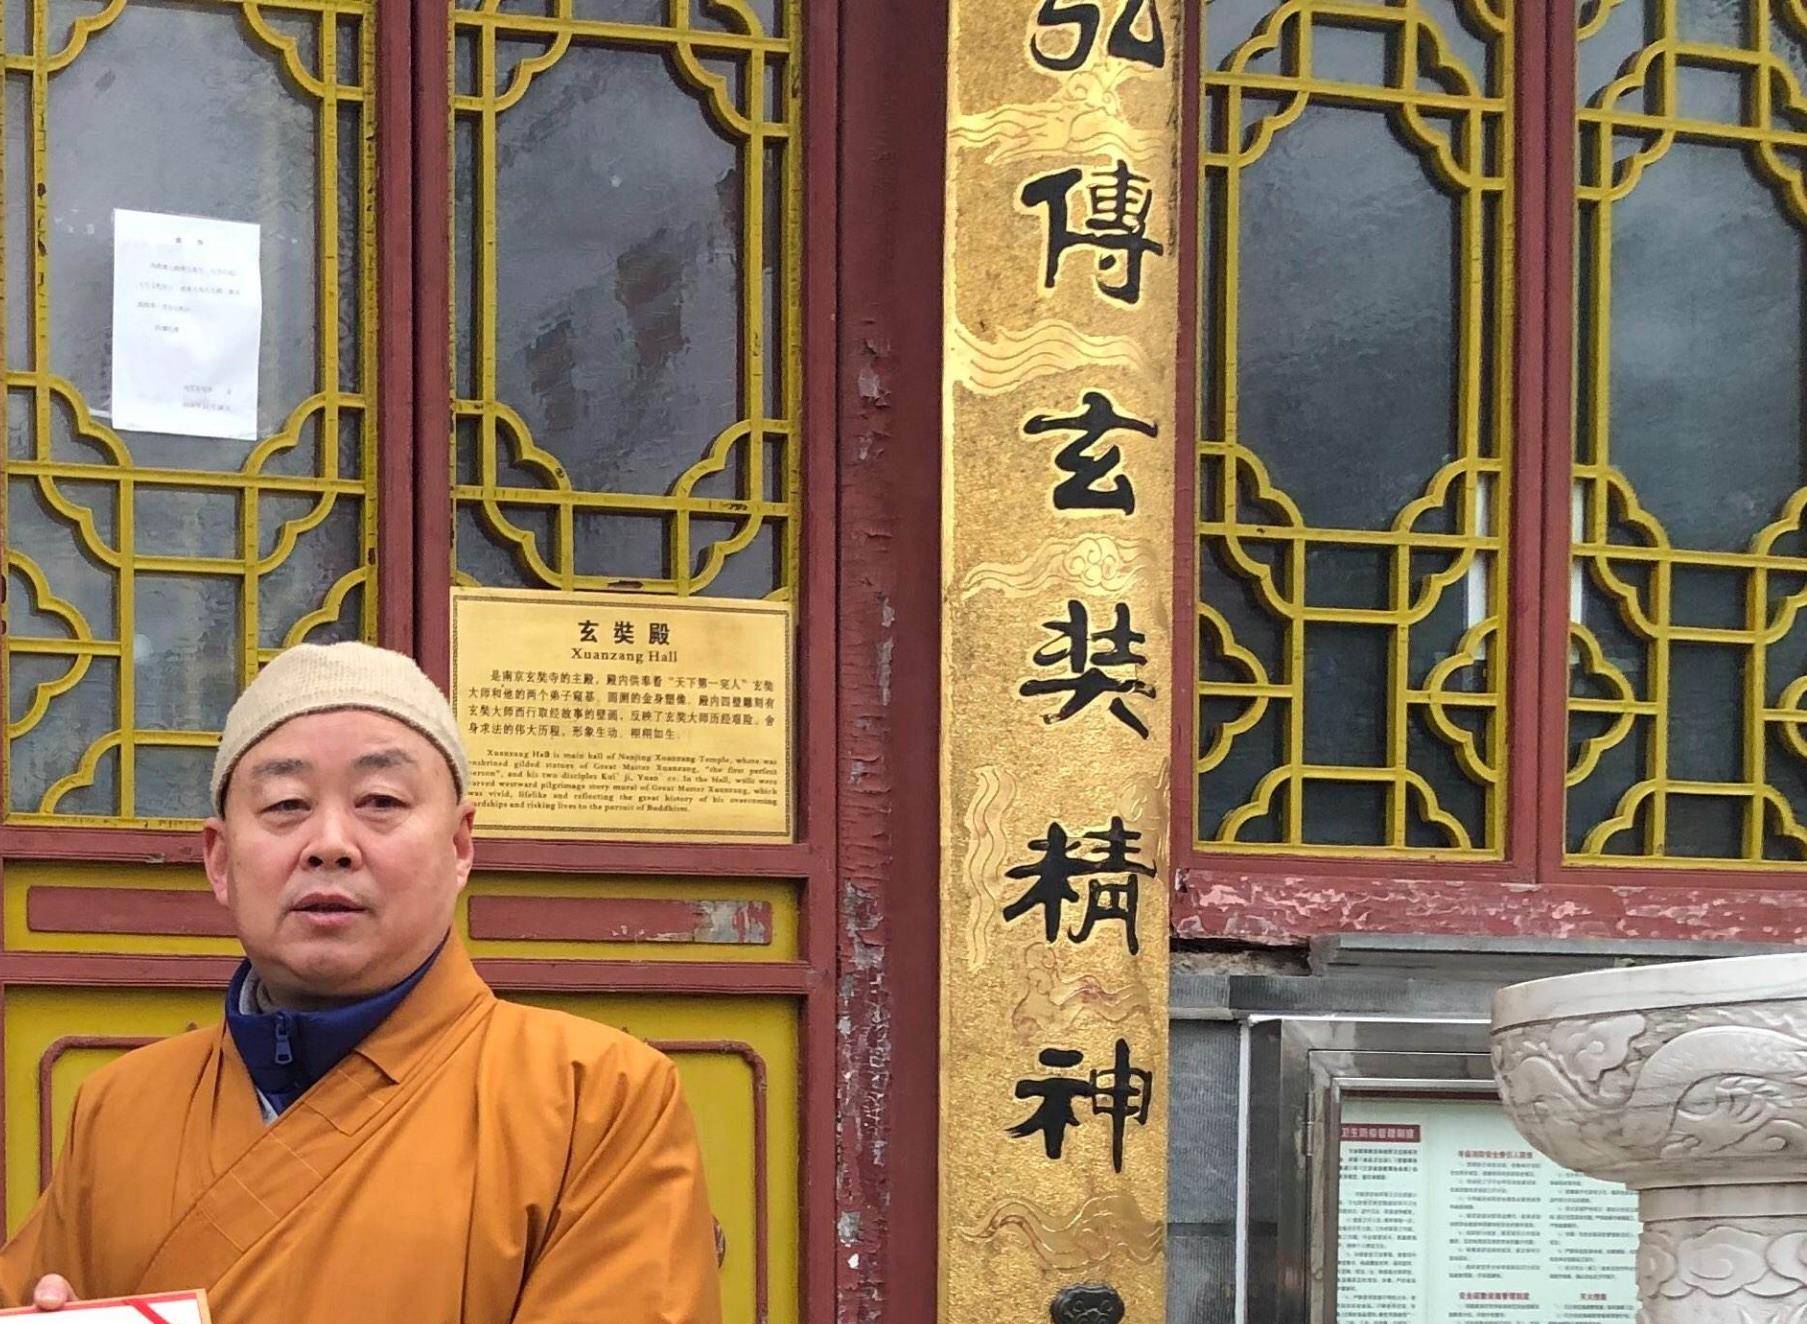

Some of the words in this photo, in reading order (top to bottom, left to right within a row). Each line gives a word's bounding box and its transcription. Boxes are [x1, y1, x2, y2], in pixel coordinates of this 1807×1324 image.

[578, 620, 670, 645] 玄奘殿
[571, 648, 644, 664] Xuanzang
[648, 650, 678, 663] Hall
[513, 760, 541, 770] gilded
[593, 763, 616, 771] Great
[622, 764, 650, 772] Master
[561, 772, 597, 782] disciples
[541, 781, 586, 791] pilgrimage
[574, 792, 615, 802] reflecting
[638, 794, 660, 804] great
[527, 800, 556, 810] risking
